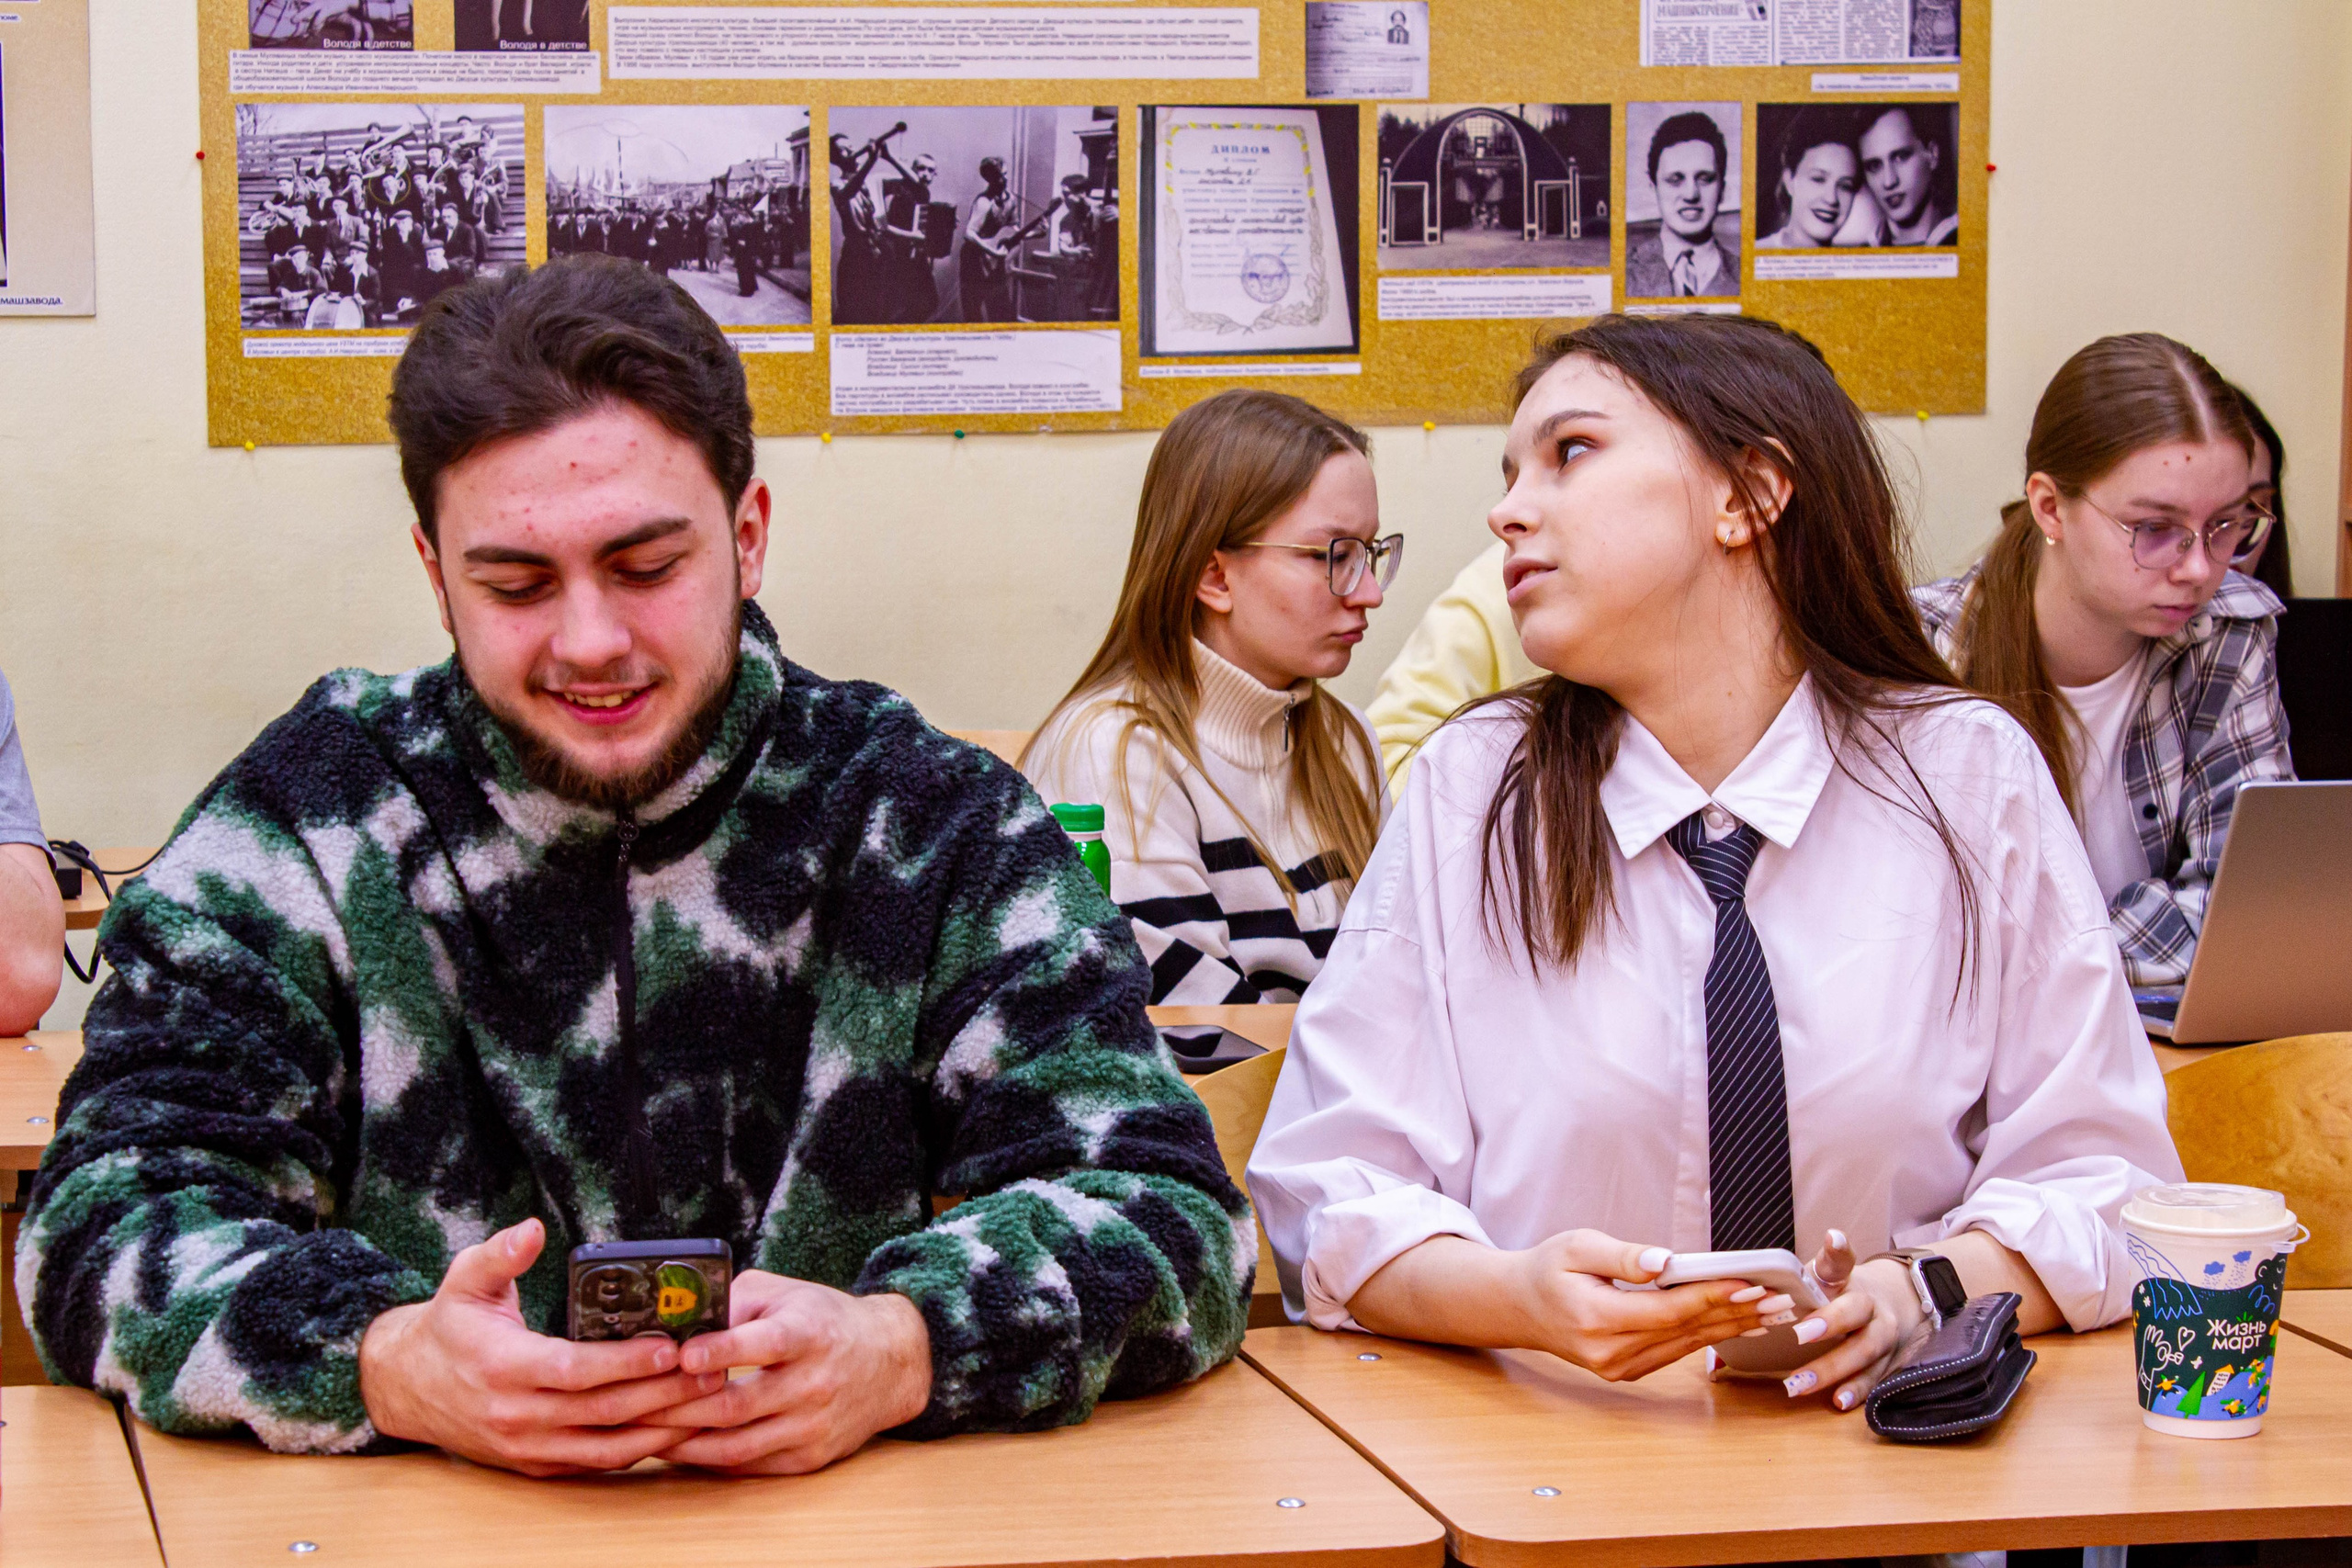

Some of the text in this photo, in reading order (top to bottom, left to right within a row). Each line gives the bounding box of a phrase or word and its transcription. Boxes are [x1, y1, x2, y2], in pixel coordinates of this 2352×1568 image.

[323, 38, 362, 49] Володя
[500, 39, 537, 50] Володя
[548, 42, 587, 51] детстве
[2207, 1318, 2267, 1337] Жизнь
[2212, 1334, 2263, 1355] март
